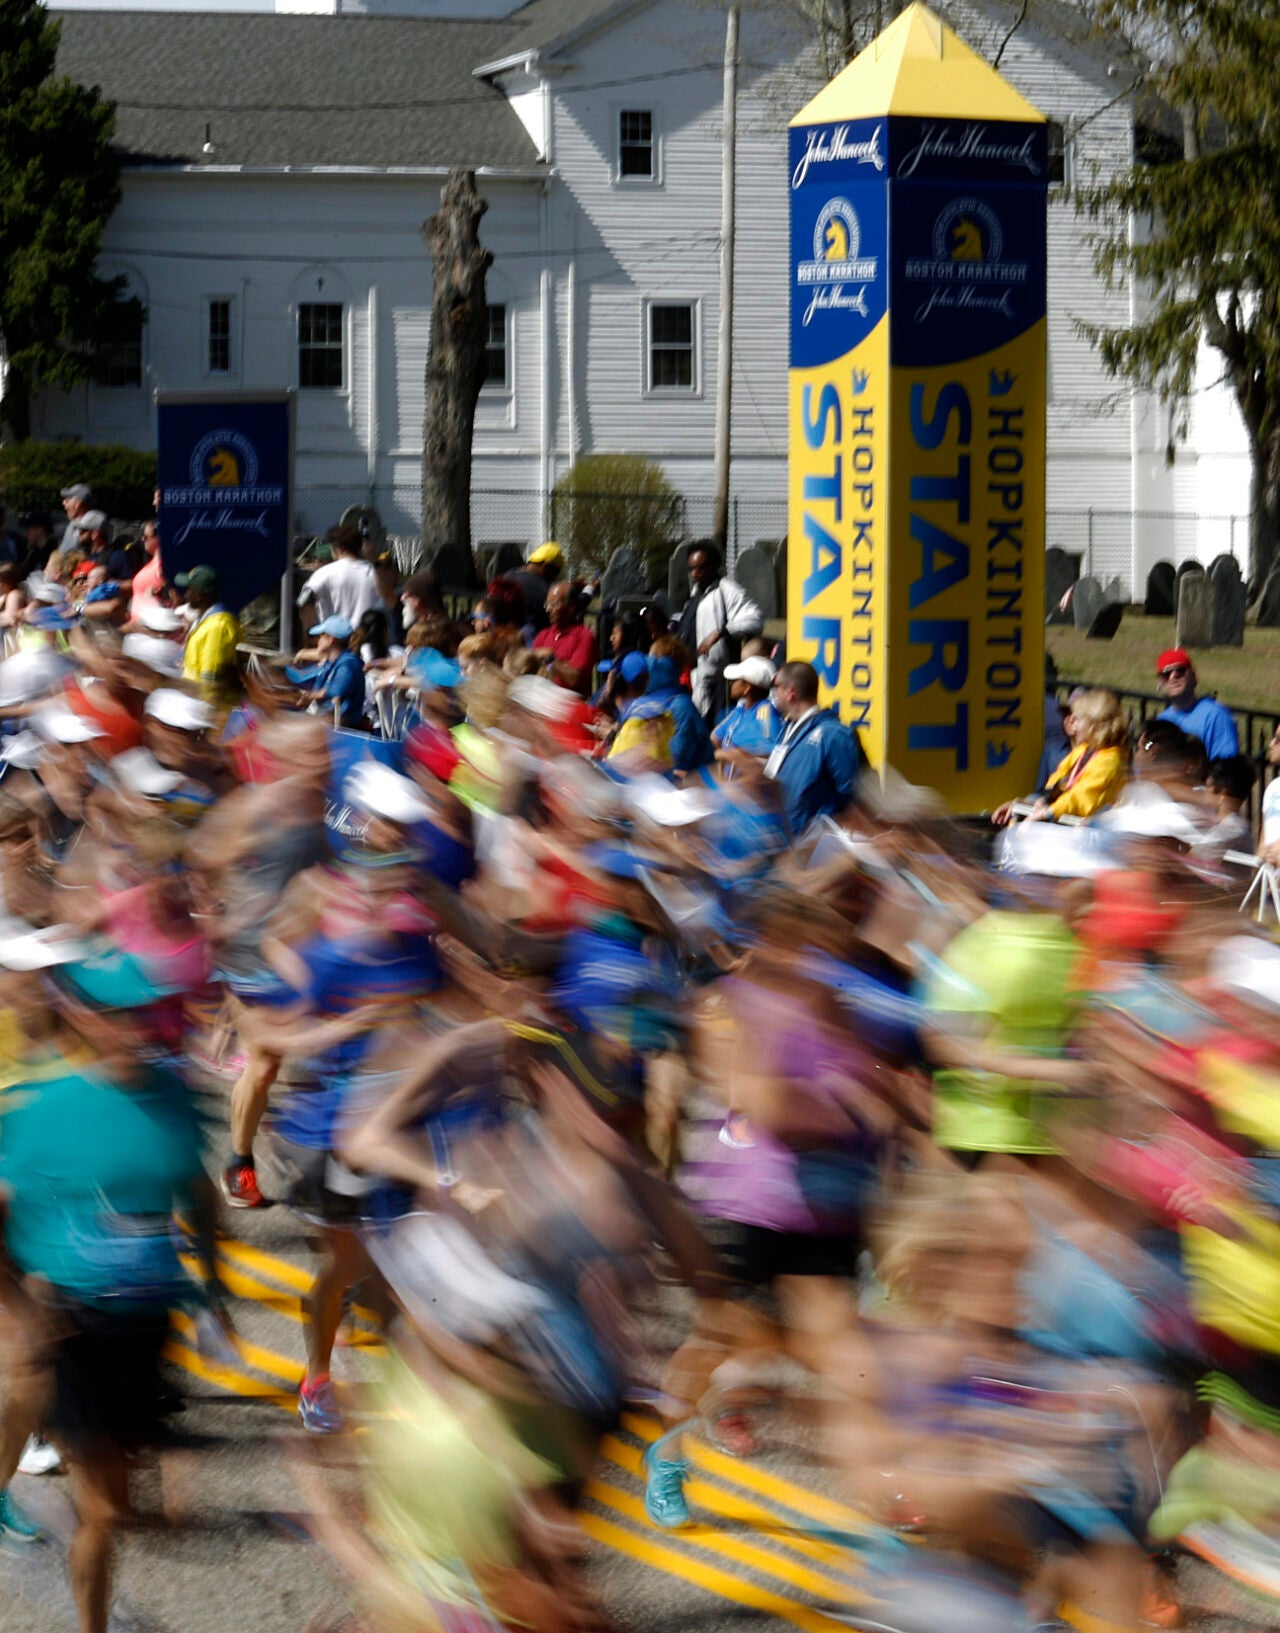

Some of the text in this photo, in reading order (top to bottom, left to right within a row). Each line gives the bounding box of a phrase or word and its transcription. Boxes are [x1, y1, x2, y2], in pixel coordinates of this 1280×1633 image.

[792, 123, 886, 189] John Hancock
[896, 123, 1041, 180] John Hancock
[797, 262, 876, 280] BOSTON MARATHON
[905, 263, 1028, 281] BOSTON MARATHON
[802, 283, 869, 327] John Hancock
[913, 283, 1016, 324] John Hancock
[164, 487, 282, 504] BOSTON MARATHON
[172, 507, 271, 546] John Hancock
[802, 381, 843, 725] STAR
[851, 405, 874, 731] HOPKINTON
[908, 381, 972, 772] START
[985, 406, 1024, 731] HOPKINTON
